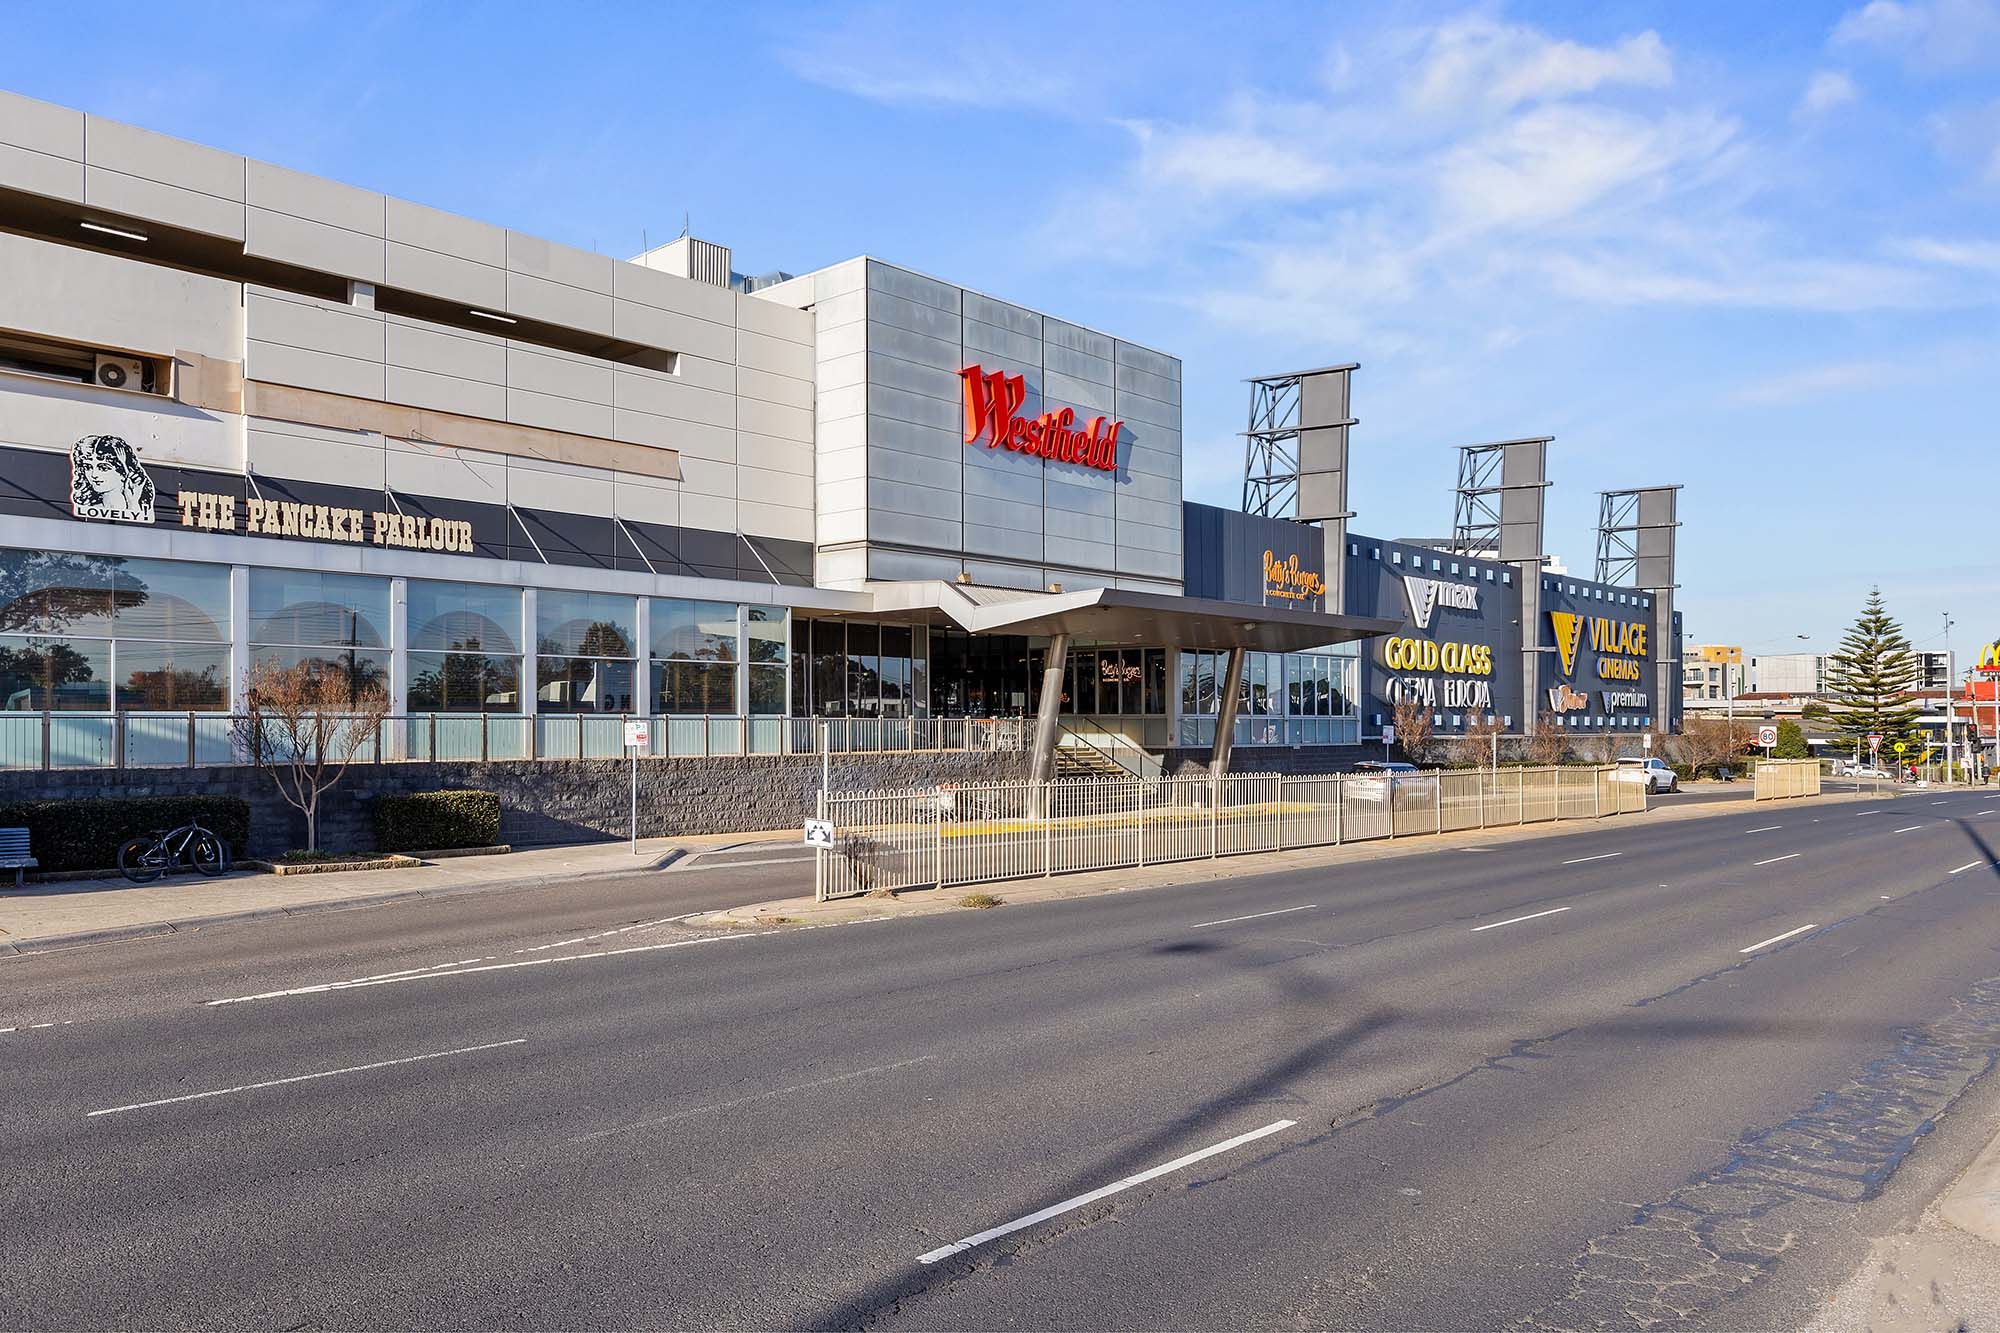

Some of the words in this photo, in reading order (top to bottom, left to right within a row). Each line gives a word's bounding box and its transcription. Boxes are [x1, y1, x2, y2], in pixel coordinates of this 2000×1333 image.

[957, 364, 1124, 471] Westfield
[77, 505, 149, 521] LOVELY!
[178, 491, 235, 530] THE
[246, 498, 363, 542] PANCAKE
[373, 511, 474, 552] PARLOUR
[1263, 549, 1290, 589] Betty's
[1289, 553, 1326, 595] Burgers
[1586, 616, 1647, 656] VILLAGE
[1385, 637, 1439, 671] GOLD
[1441, 642, 1492, 675] CLASS
[1597, 657, 1640, 680] CINEMAS
[1443, 679, 1491, 708] EUROPA
